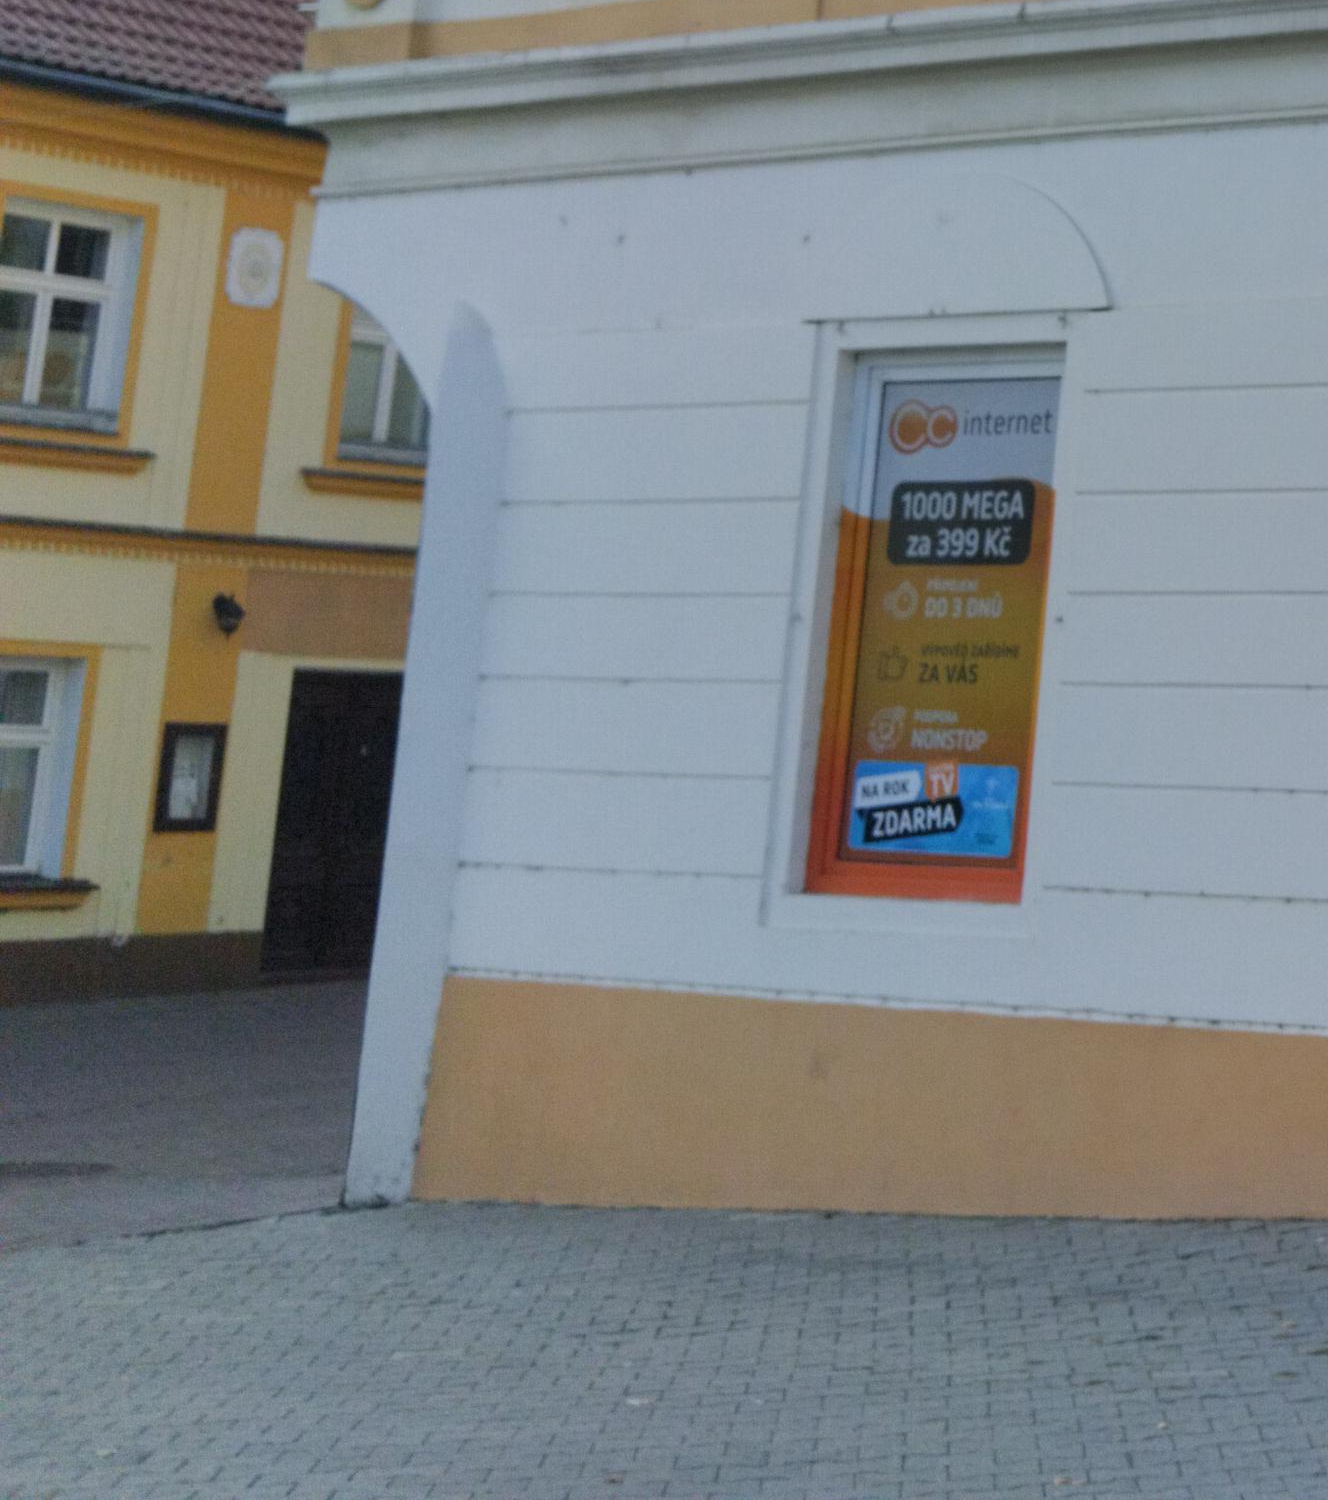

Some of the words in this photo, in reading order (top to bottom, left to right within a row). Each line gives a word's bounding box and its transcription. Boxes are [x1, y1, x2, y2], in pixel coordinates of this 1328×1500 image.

[963, 409, 1053, 436] internet
[901, 491, 957, 520] 1000
[961, 490, 1024, 520] MEGA
[907, 535, 932, 557] za
[936, 528, 979, 557] 399
[984, 526, 1012, 558] Kč
[918, 663, 940, 684] ZA
[861, 783, 880, 798] NA
[882, 779, 911, 797] ROK
[872, 803, 957, 837] ZDARMA
